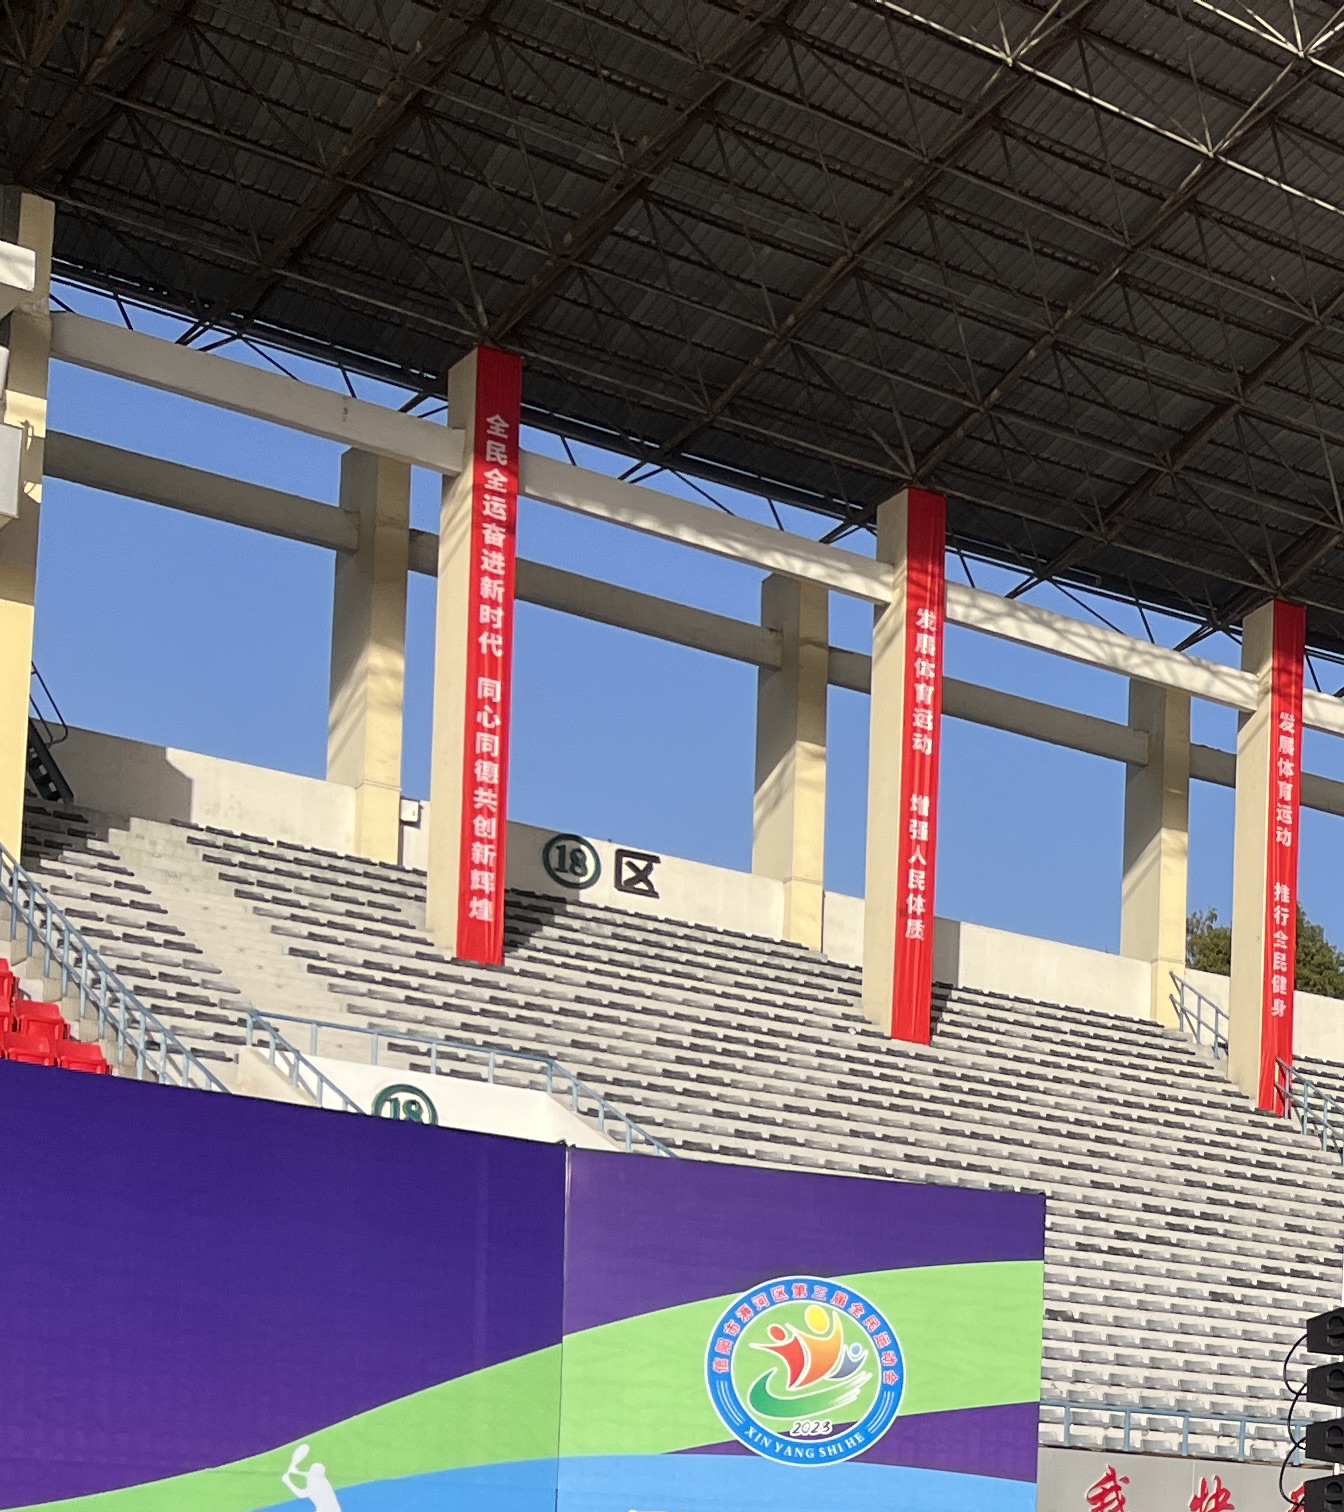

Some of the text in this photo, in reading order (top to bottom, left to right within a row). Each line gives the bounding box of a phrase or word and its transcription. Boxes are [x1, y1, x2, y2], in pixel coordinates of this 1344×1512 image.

[468, 413, 510, 923] 全民全运奋进新时代 同心同德共创新辉煌
[905, 608, 938, 942] 发展体育运动 增强人民体质
[614, 848, 662, 900] 区
[1270, 712, 1296, 1019] 发展体育运动 推行全民健身
[744, 1425, 866, 1459] XIN YANG SHI HE
[791, 1420, 832, 1436] 2023
